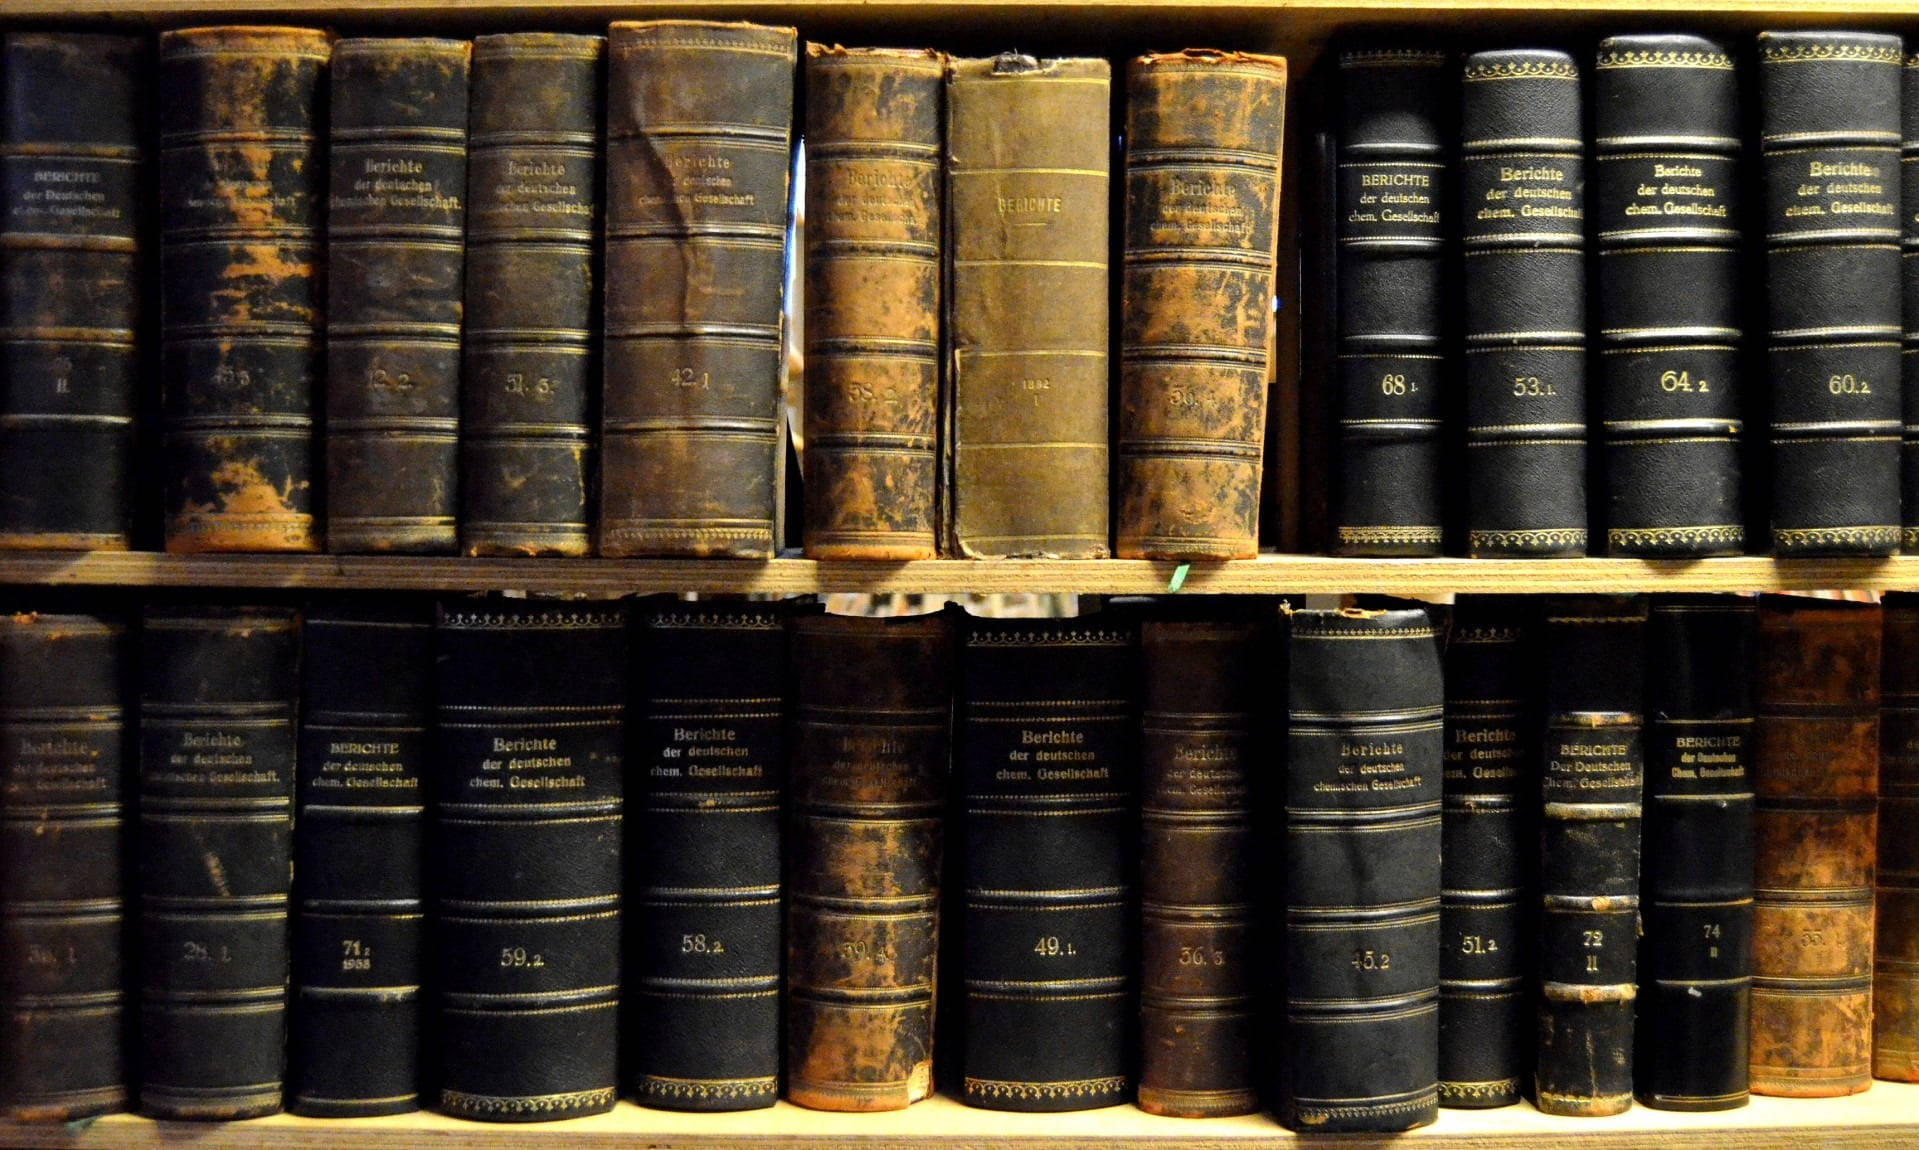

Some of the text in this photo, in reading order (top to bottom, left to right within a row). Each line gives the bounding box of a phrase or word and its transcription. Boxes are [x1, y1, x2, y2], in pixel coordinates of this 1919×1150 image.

[1500, 166, 1564, 182] Berichte
[1654, 164, 1703, 178] Berichte
[1809, 161, 1873, 178] Berichte
[1361, 173, 1430, 188] BERICHTE
[1486, 185, 1572, 201] der deutschen
[1637, 182, 1715, 198] der deutschen
[1797, 183, 1882, 197] der deutschen
[1359, 190, 1430, 205] der deutschen
[1348, 209, 1377, 223] chem.
[1477, 208, 1515, 219] chem.
[1625, 201, 1728, 218] chem. Gesellschaft
[1785, 202, 1895, 217] chem. Gesellschaft
[673, 727, 736, 742] Berichte
[1021, 730, 1084, 745] Berichte
[330, 741, 401, 755] BERICHTE
[493, 737, 557, 752] Berichte
[1560, 743, 1628, 756] BERICHTE
[1675, 736, 1742, 749] BERICHTE
[663, 745, 749, 759] der deutschen
[1009, 749, 1095, 761] der deutschen
[1341, 743, 1403, 758] Berichte
[322, 760, 341, 772] der
[482, 756, 572, 771] der deutschen
[1360, 762, 1405, 775] deutschen
[1575, 760, 1632, 773] Deutschen
[650, 765, 764, 779] chem. Gesellschaft
[995, 768, 1110, 781] chem. Gesellschaft
[469, 775, 586, 789] chem. Gesellschaft
[1703, 923, 1721, 939] 74
[1583, 930, 1604, 948] 72
